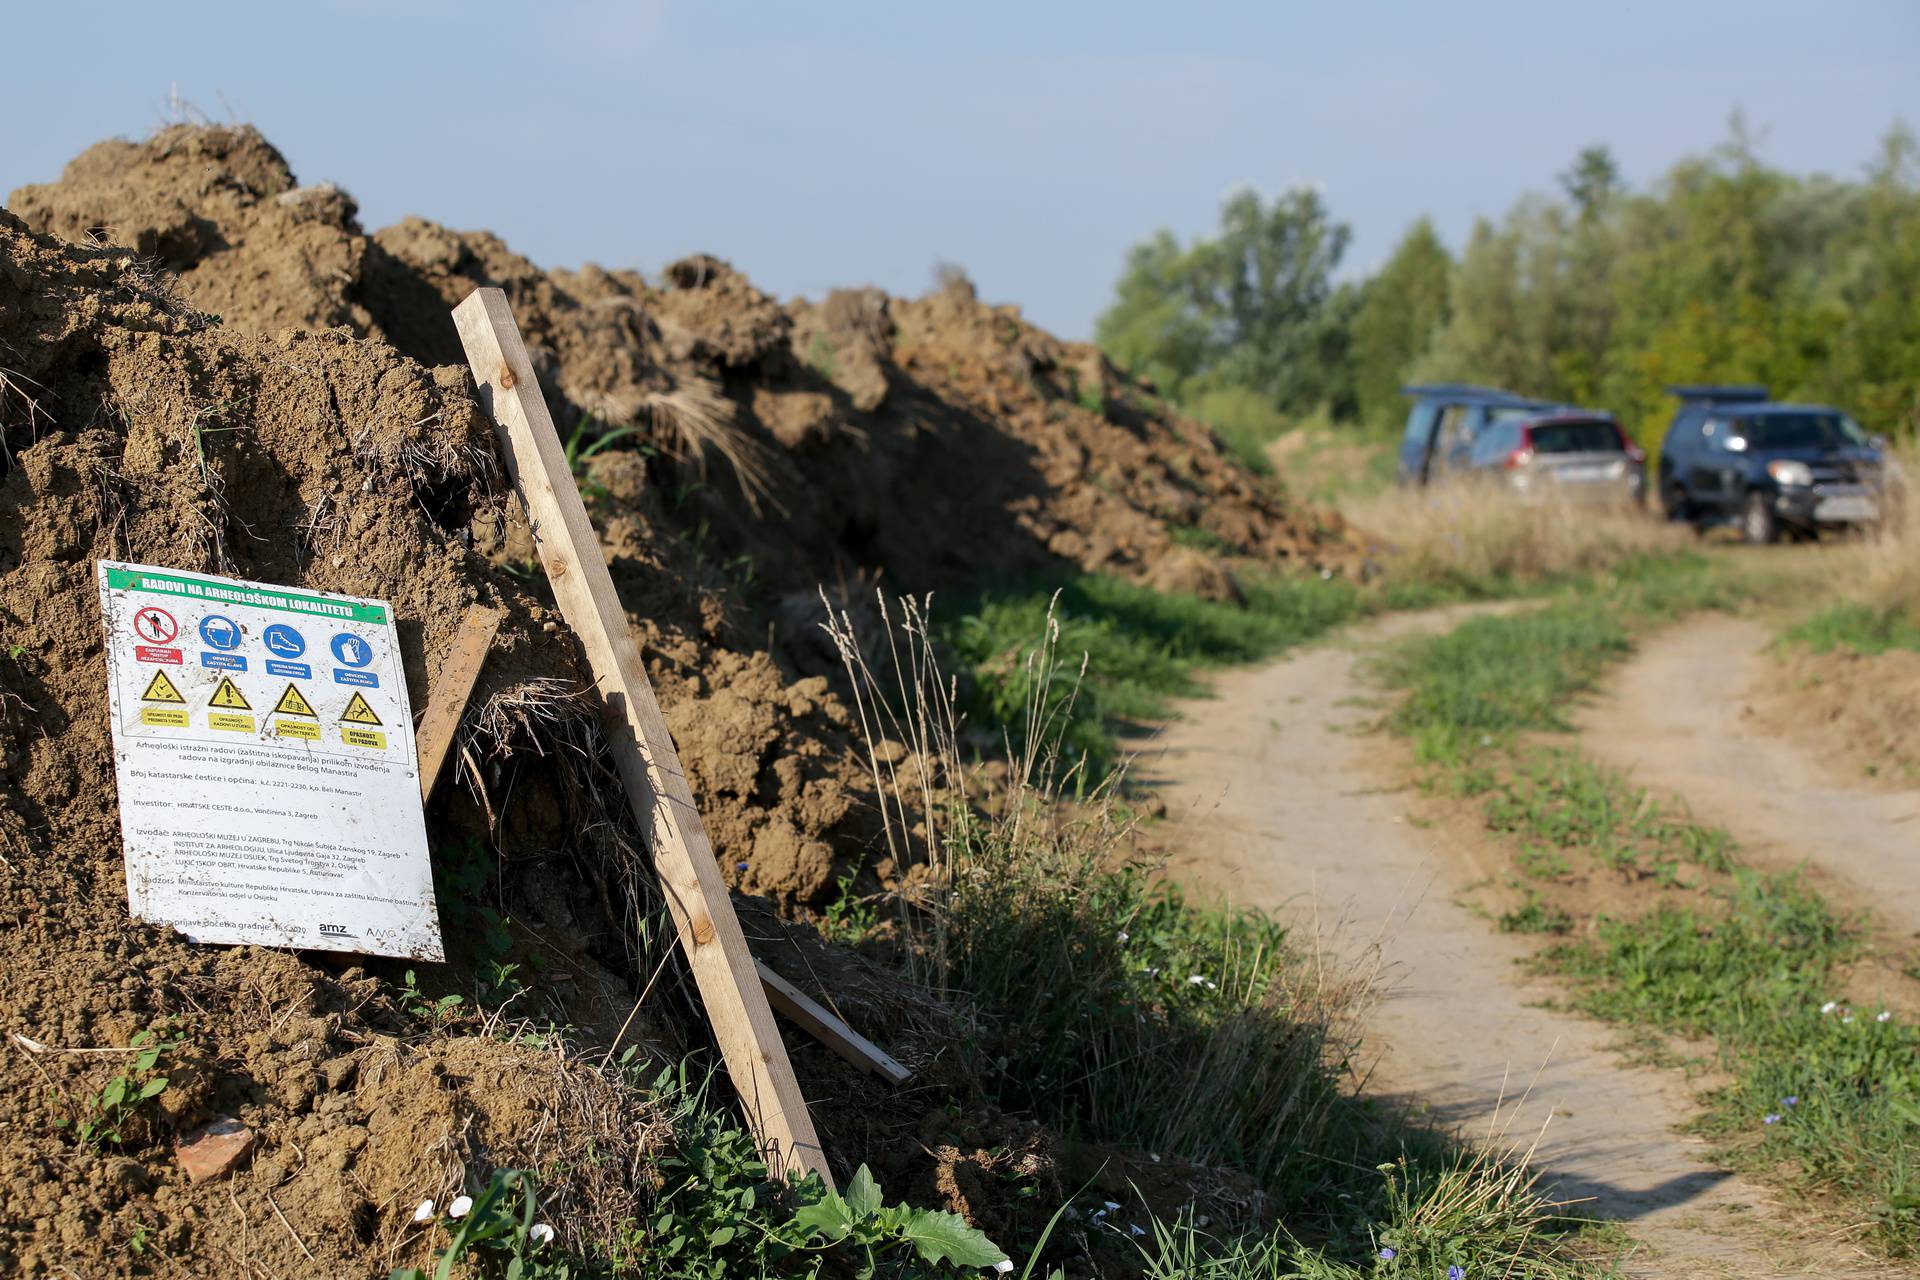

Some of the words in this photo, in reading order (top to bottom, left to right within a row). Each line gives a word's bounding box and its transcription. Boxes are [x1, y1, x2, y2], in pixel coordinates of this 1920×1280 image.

[142, 578, 186, 593] RADOVI
[188, 583, 204, 596] NA
[205, 586, 288, 608] ARHEOLOŠKOM
[289, 599, 353, 617] LOKALITETU
[350, 731, 376, 739] OPASNOST
[136, 742, 179, 750] Arheološki
[210, 746, 236, 754] radovi
[238, 748, 270, 758] (zaštitna
[272, 752, 320, 763] iskopavanja)
[322, 758, 353, 768] prilikom
[354, 761, 390, 774] izvođenja
[220, 756, 254, 767] izgradnji
[256, 758, 296, 770] obilaznice
[296, 764, 318, 774] Belog
[320, 767, 358, 778] Manastira
[130, 770, 146, 778] Broj
[148, 770, 193, 780] katastarske
[194, 774, 222, 782] čestice
[228, 776, 257, 784] općina:
[334, 788, 362, 797] Manastir
[177, 802, 210, 810] HRVATSKE
[295, 812, 318, 820] Zagreb
[172, 831, 216, 840] ARHEOLOŠKI
[248, 836, 280, 845] ZAGREBU,
[378, 850, 401, 859] Zagreb
[174, 849, 218, 858] ARHEOLOŠKI
[280, 856, 303, 865] Svetog
[316, 852, 331, 860] Gaja
[342, 855, 366, 864] Zagreb
[268, 866, 301, 874] Republike
[178, 878, 220, 887] Ministarstvo
[220, 881, 244, 889] kulture
[245, 883, 278, 892] Republike
[280, 886, 310, 895] Hrvatske,
[311, 889, 335, 897] Uprava
[344, 892, 366, 900] zaštitu
[319, 923, 347, 933] amz
